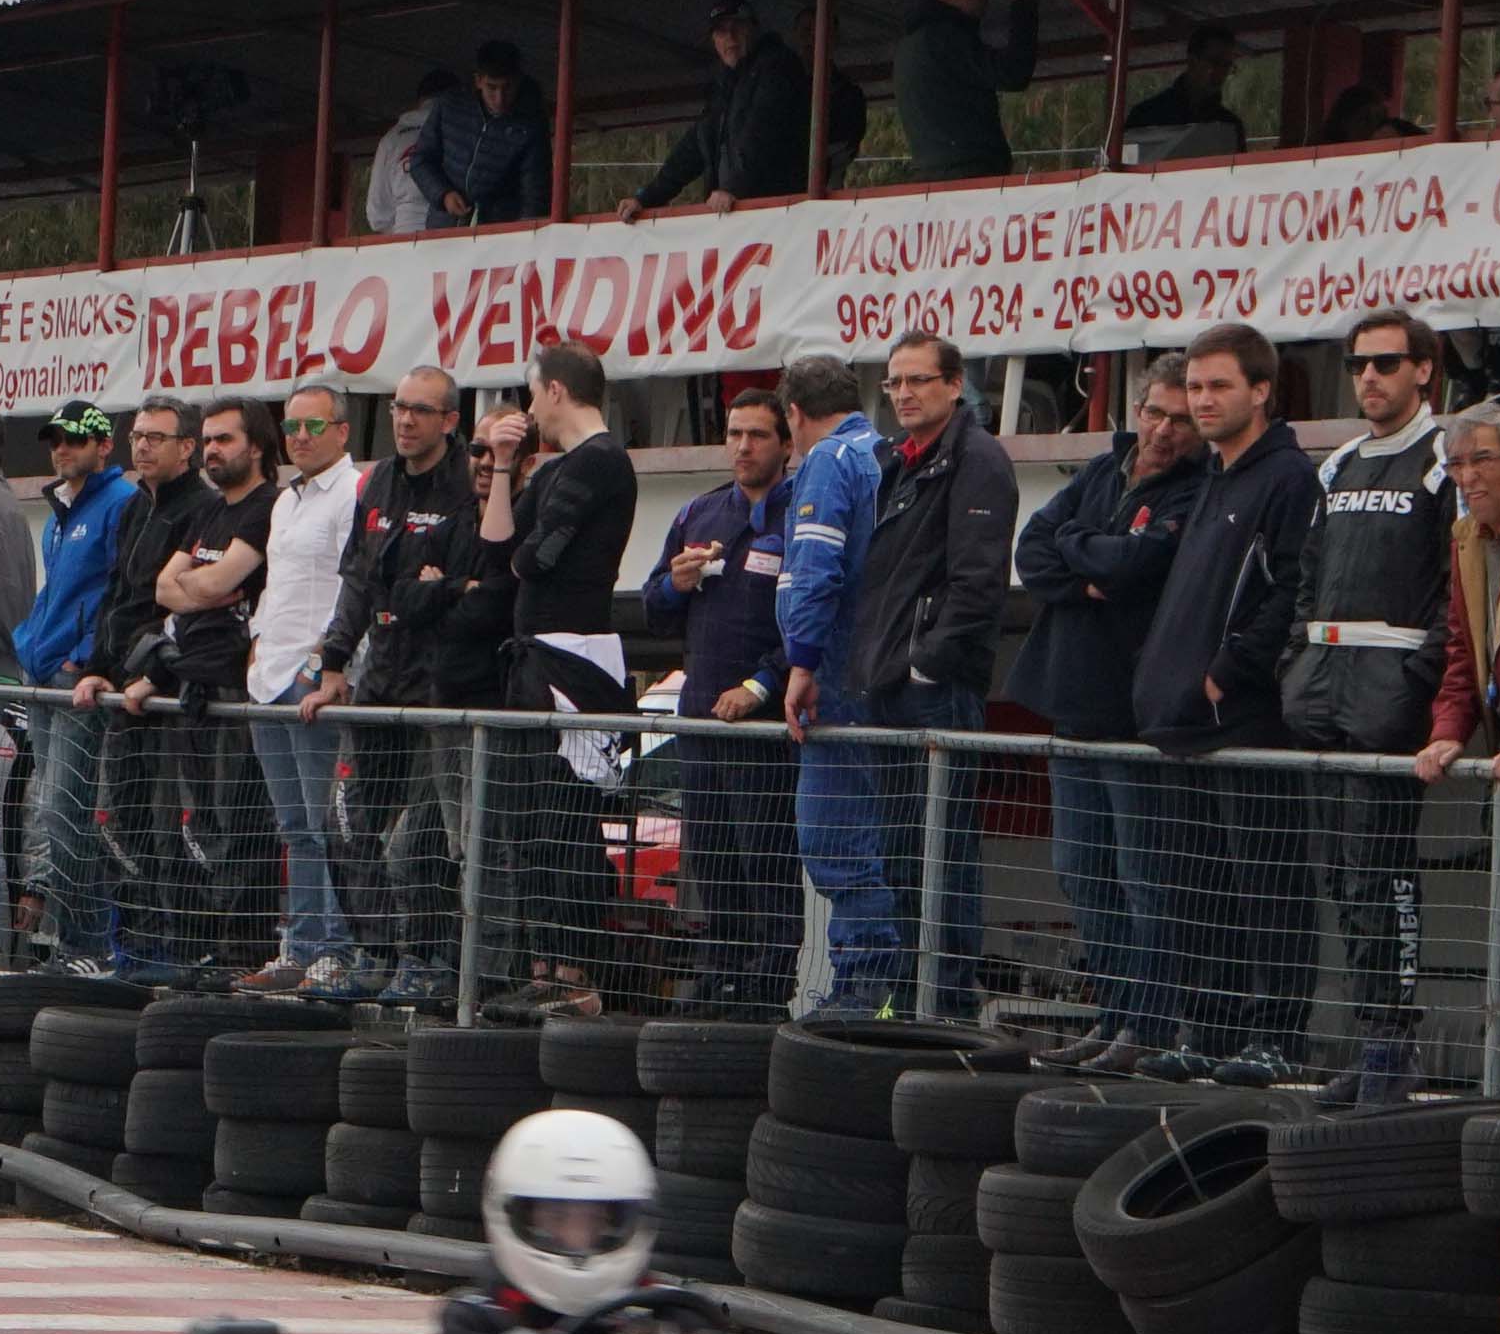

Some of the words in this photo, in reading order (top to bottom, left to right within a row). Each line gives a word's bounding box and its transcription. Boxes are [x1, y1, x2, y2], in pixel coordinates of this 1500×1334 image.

[815, 213, 995, 276] MÁQUINAS
[1003, 211, 1055, 262] DE
[1063, 202, 1182, 257] VENDA
[1191, 171, 1448, 251] AUTOMÁTICA
[20, 302, 34, 340] E
[41, 293, 137, 340] SNACKS
[143, 276, 387, 390] REBELO
[432, 243, 773, 369] VENDING
[836, 293, 895, 343] 969
[904, 288, 955, 336] 061
[969, 282, 1023, 335] 234
[1053, 275, 1099, 330] 262
[1106, 270, 1182, 320] 989
[1194, 268, 1257, 319] 270
[1326, 490, 1414, 515] SIEMENS
